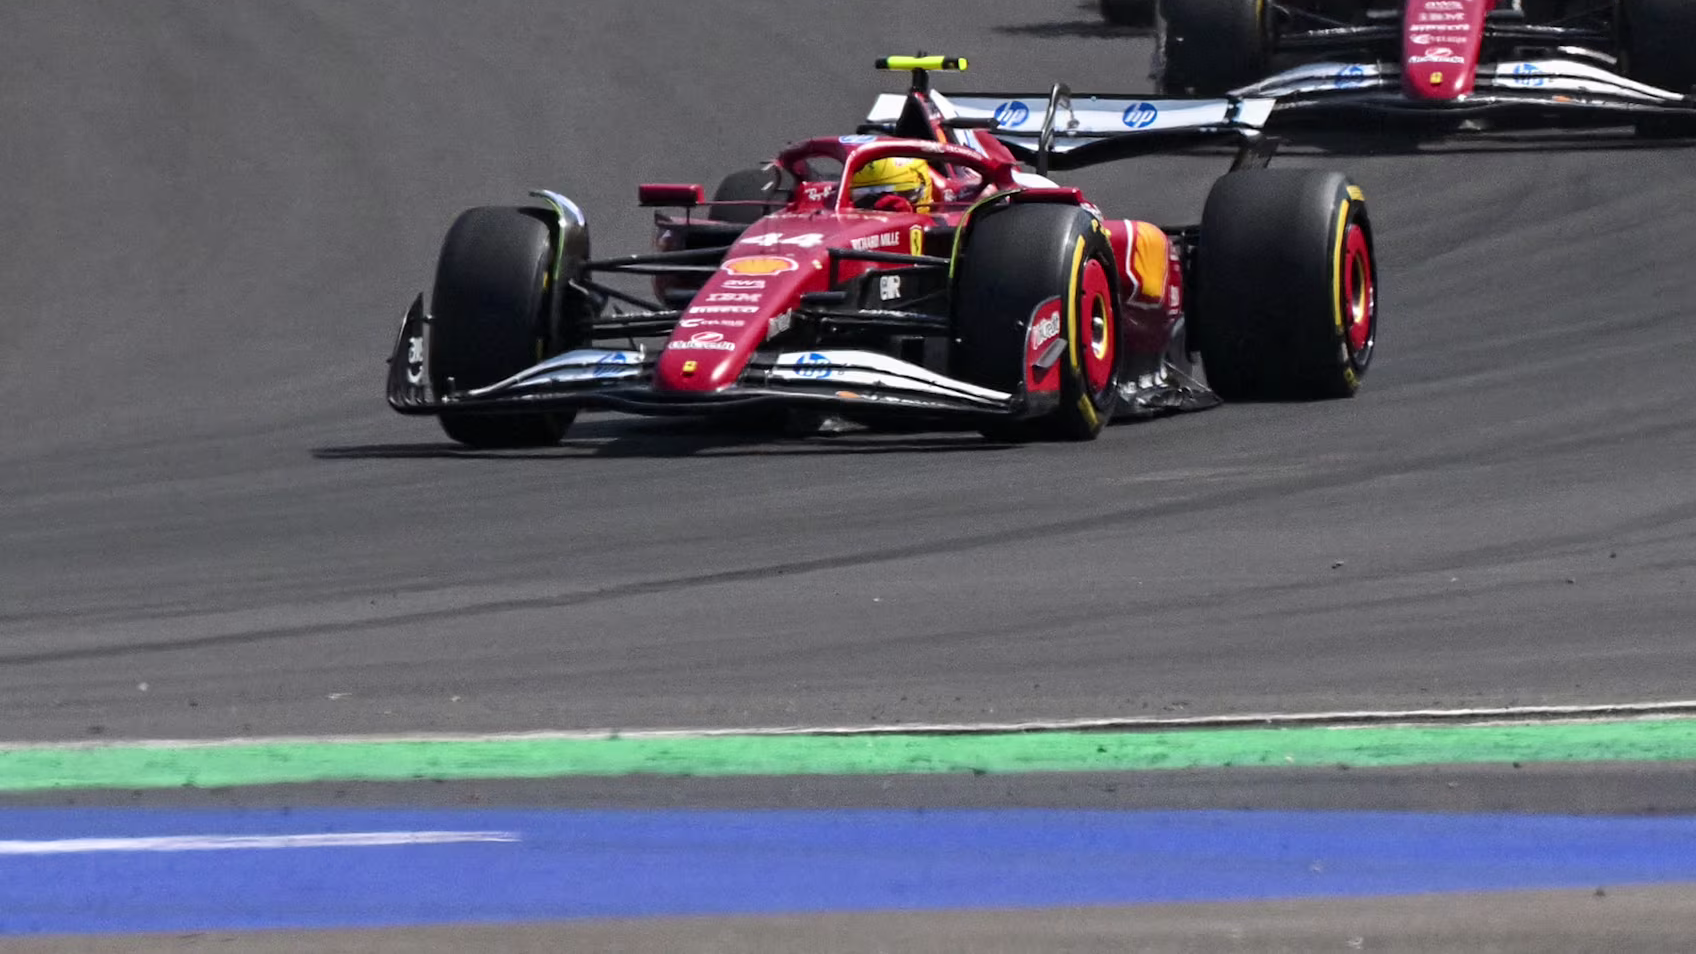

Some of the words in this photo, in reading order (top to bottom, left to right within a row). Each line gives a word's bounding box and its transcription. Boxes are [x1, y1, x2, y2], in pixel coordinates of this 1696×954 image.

[996, 102, 1028, 127] hp
[1124, 103, 1156, 128] hp
[740, 233, 824, 246] 44
[879, 230, 900, 246] MILLE
[705, 293, 762, 302] IBM
